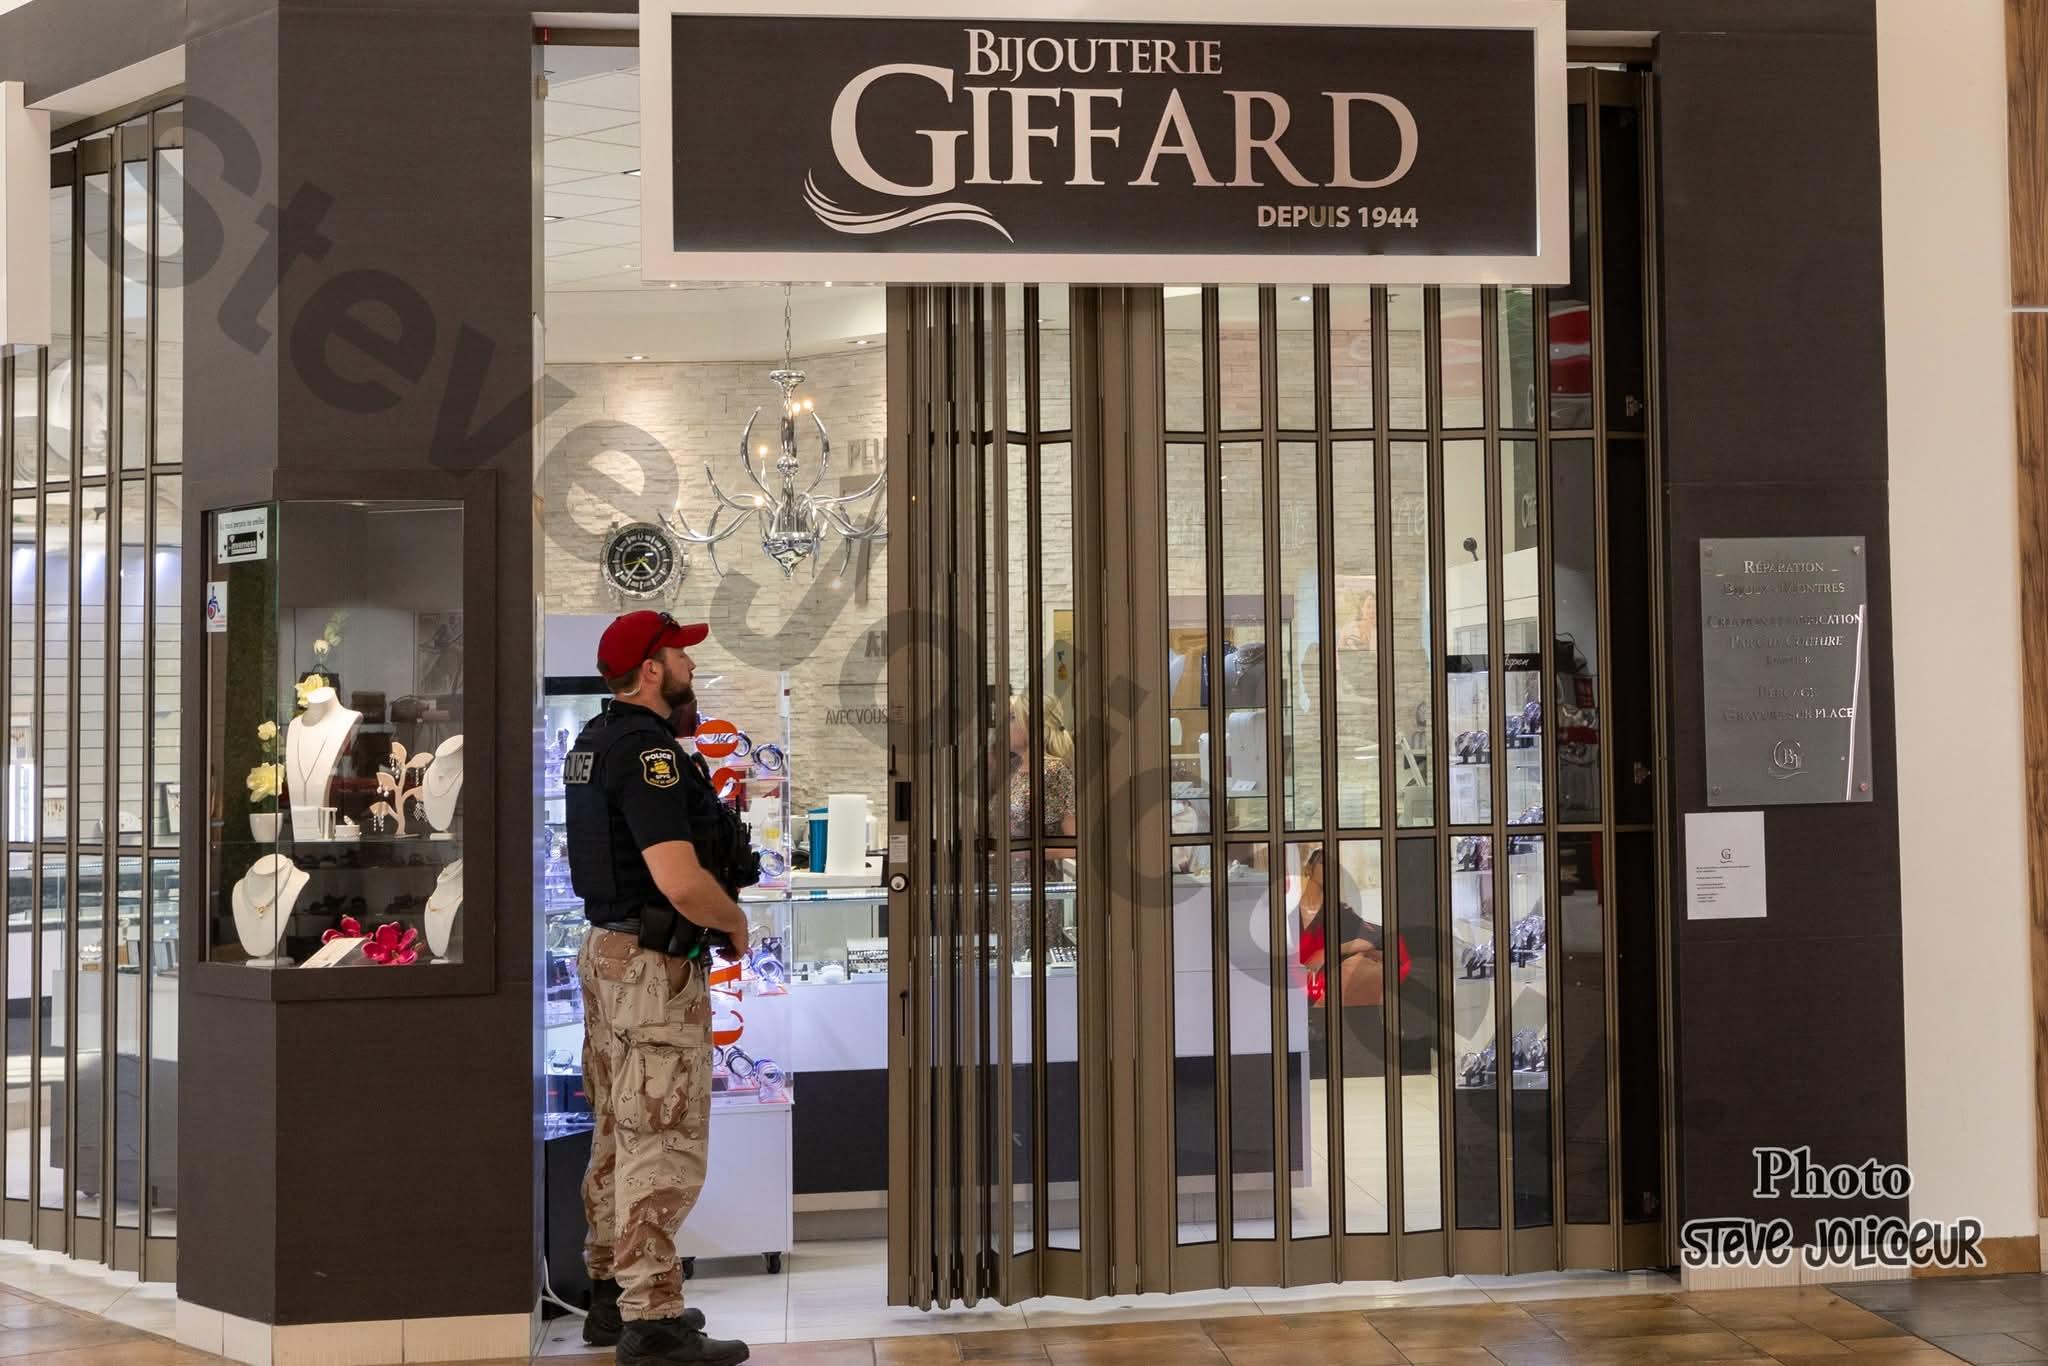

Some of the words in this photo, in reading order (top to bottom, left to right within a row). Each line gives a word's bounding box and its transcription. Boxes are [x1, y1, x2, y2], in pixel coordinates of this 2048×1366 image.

[964, 28, 1223, 82] BIJOUTERIE
[829, 63, 1419, 198] GIFFARD
[1257, 205, 1350, 229] DEPUIS
[1357, 206, 1419, 230] 1944
[645, 753, 672, 761] POLICE
